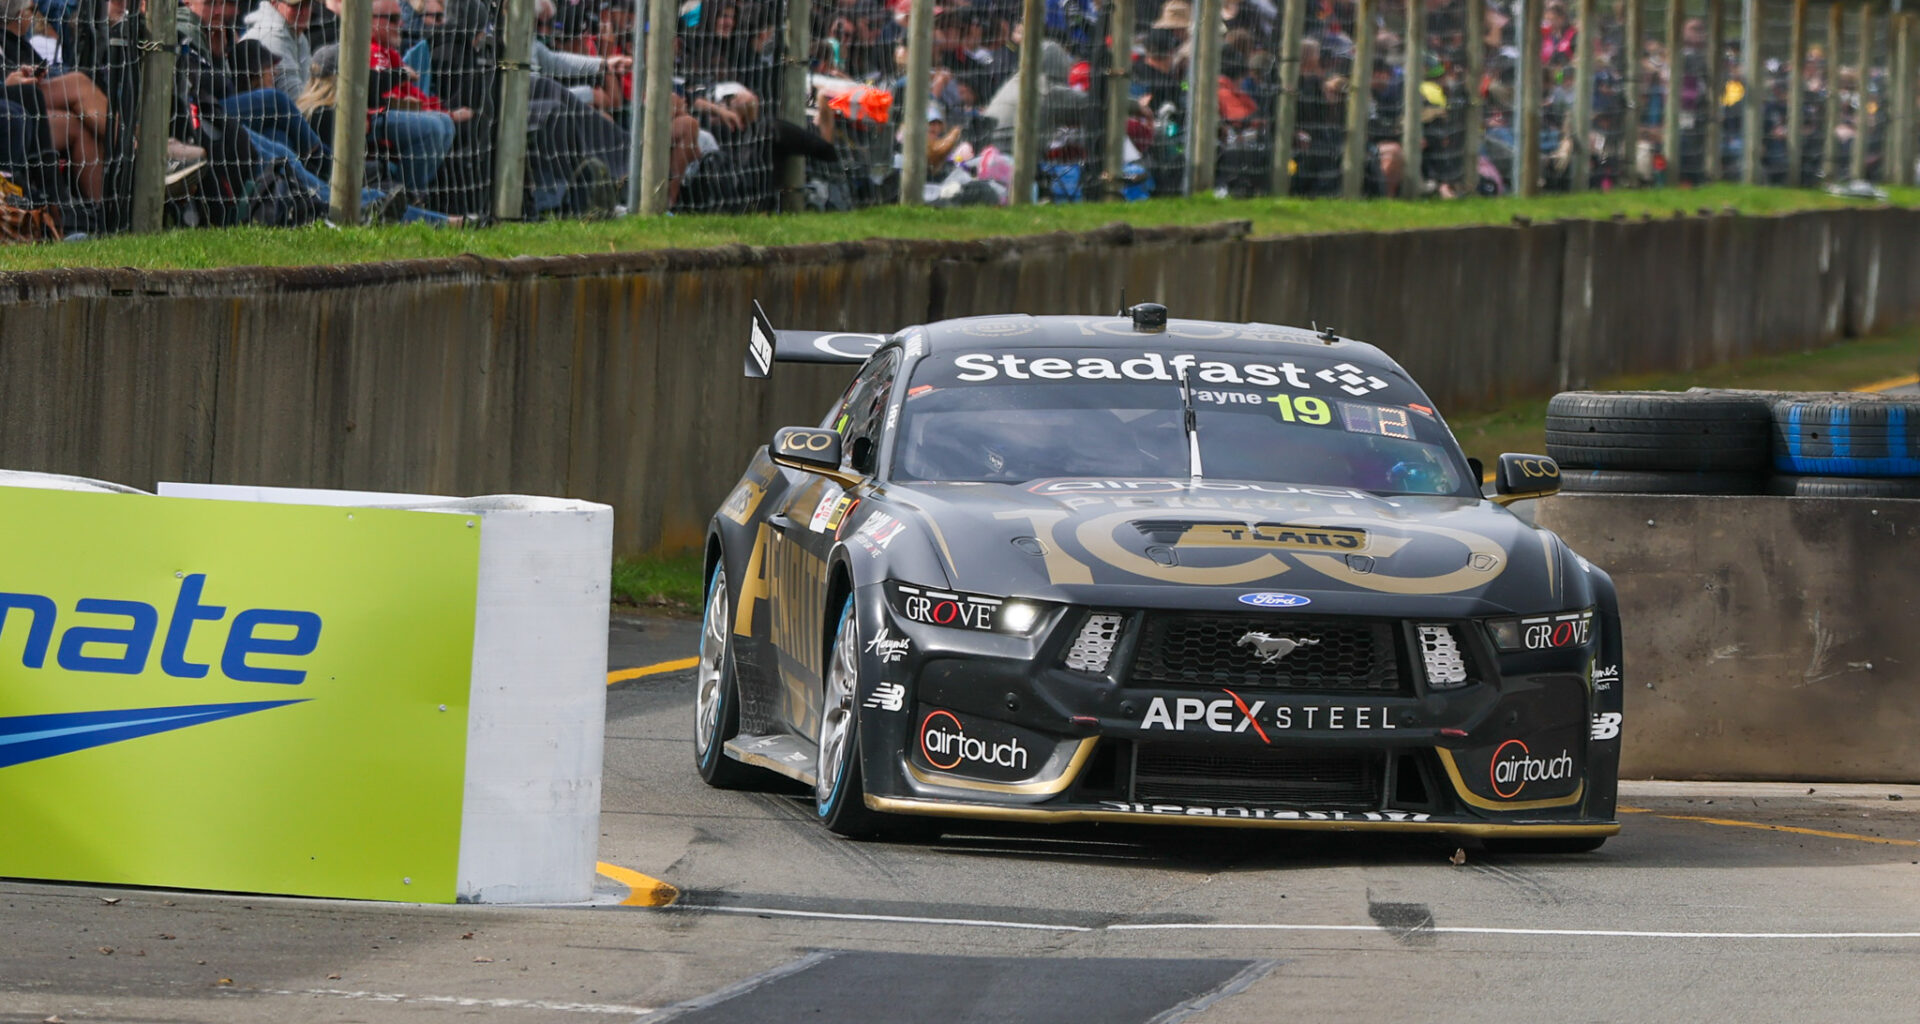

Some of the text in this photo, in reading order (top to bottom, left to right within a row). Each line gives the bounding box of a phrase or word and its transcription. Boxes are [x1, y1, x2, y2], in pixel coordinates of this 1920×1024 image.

[954, 353, 1311, 389] Steadfast
[1267, 393, 1332, 425] 19
[781, 431, 833, 451] 100
[1513, 459, 1560, 478] 100
[906, 595, 994, 630] GROVE
[1525, 619, 1589, 649] GROVE
[1140, 688, 1397, 744] APEX STEEL
[925, 727, 1028, 770] airtouch
[1495, 749, 1573, 783] airtouch
